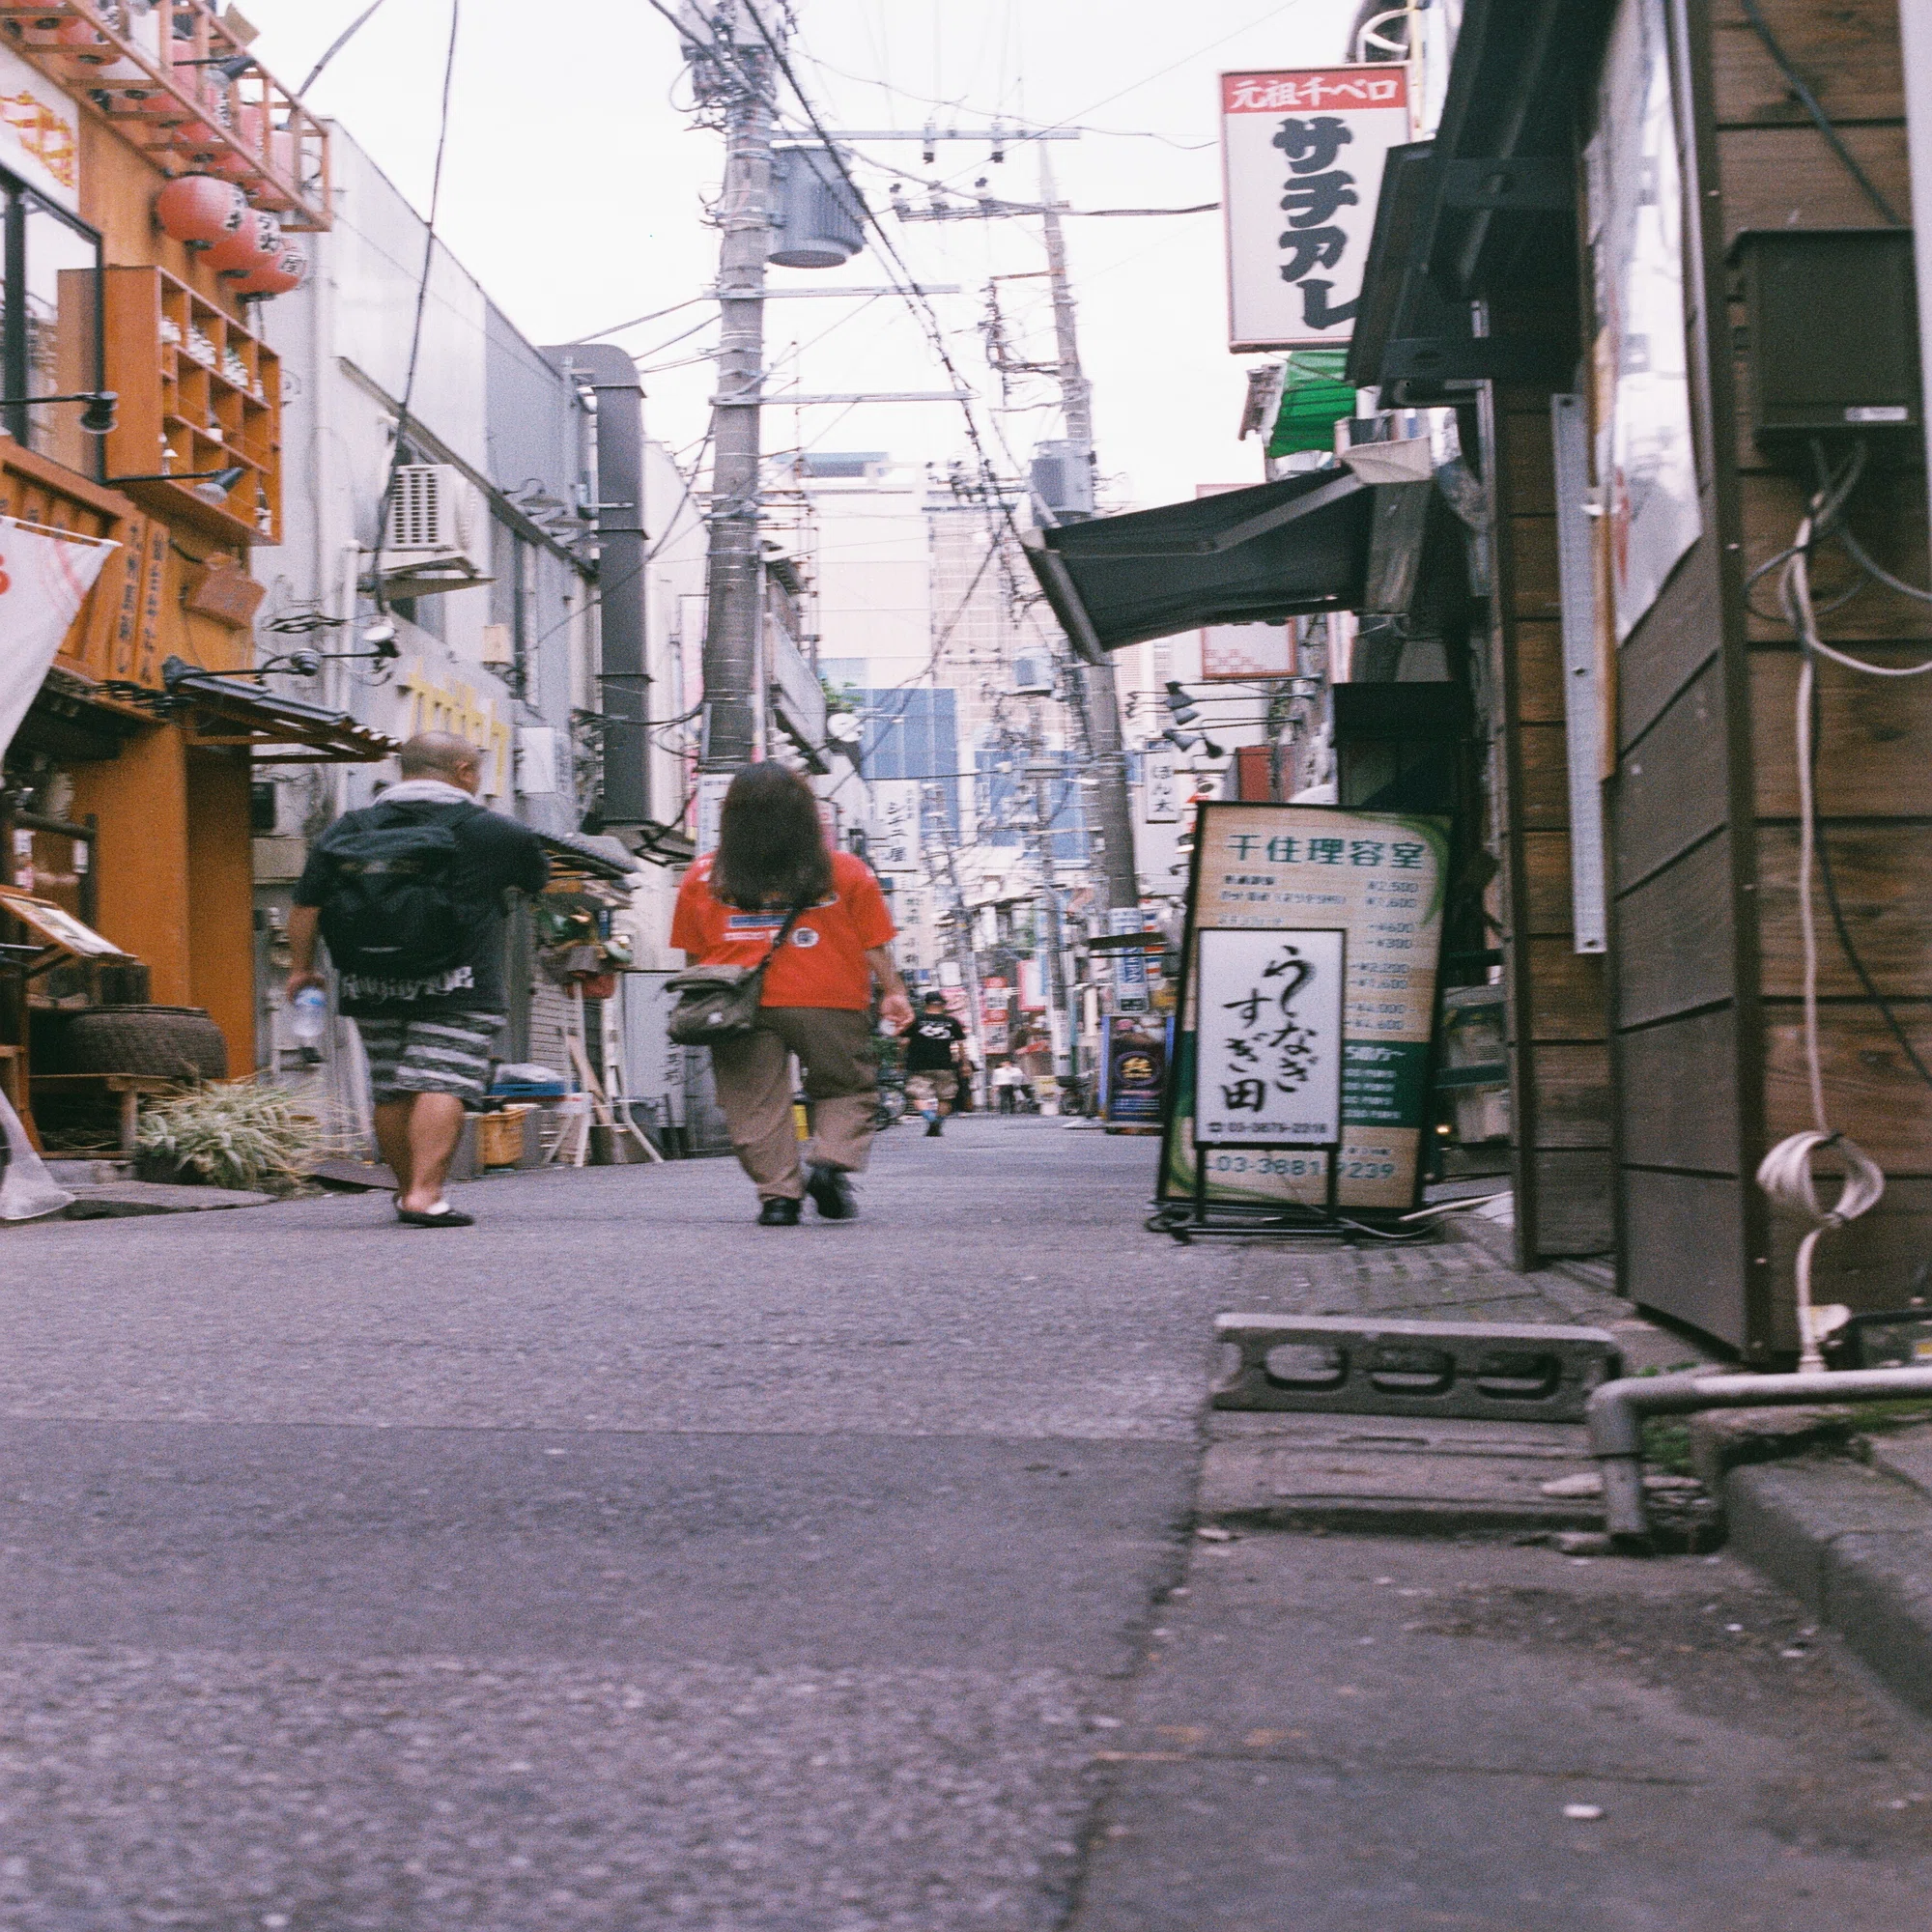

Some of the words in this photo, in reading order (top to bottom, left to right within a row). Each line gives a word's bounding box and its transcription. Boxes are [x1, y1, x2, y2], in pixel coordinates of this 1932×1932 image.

[1226, 834, 1426, 869] 千住理容室
[1220, 987, 1269, 1112] すぎ田
[1263, 945, 1320, 1094] うなぎ
